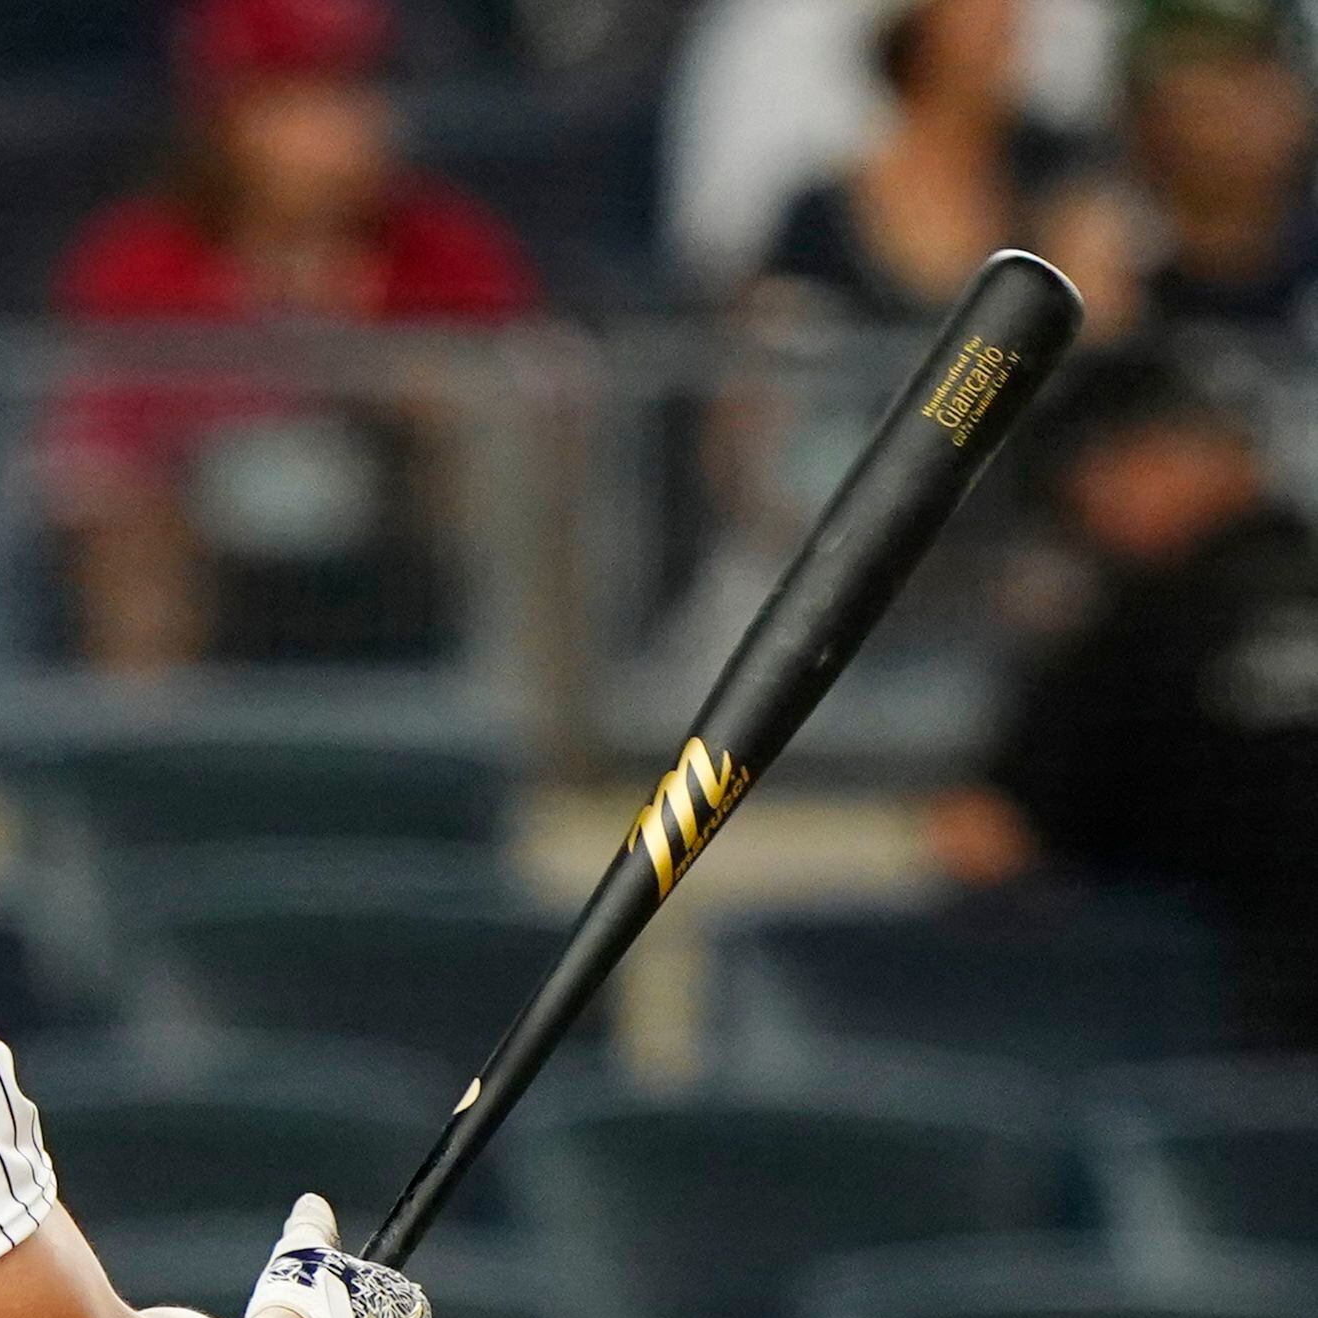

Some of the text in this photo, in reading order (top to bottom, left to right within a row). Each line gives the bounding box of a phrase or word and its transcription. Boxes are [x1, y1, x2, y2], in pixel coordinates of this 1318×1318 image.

[922, 335, 983, 417] Handcrafted For
[937, 346, 1004, 428] Giancarlo
